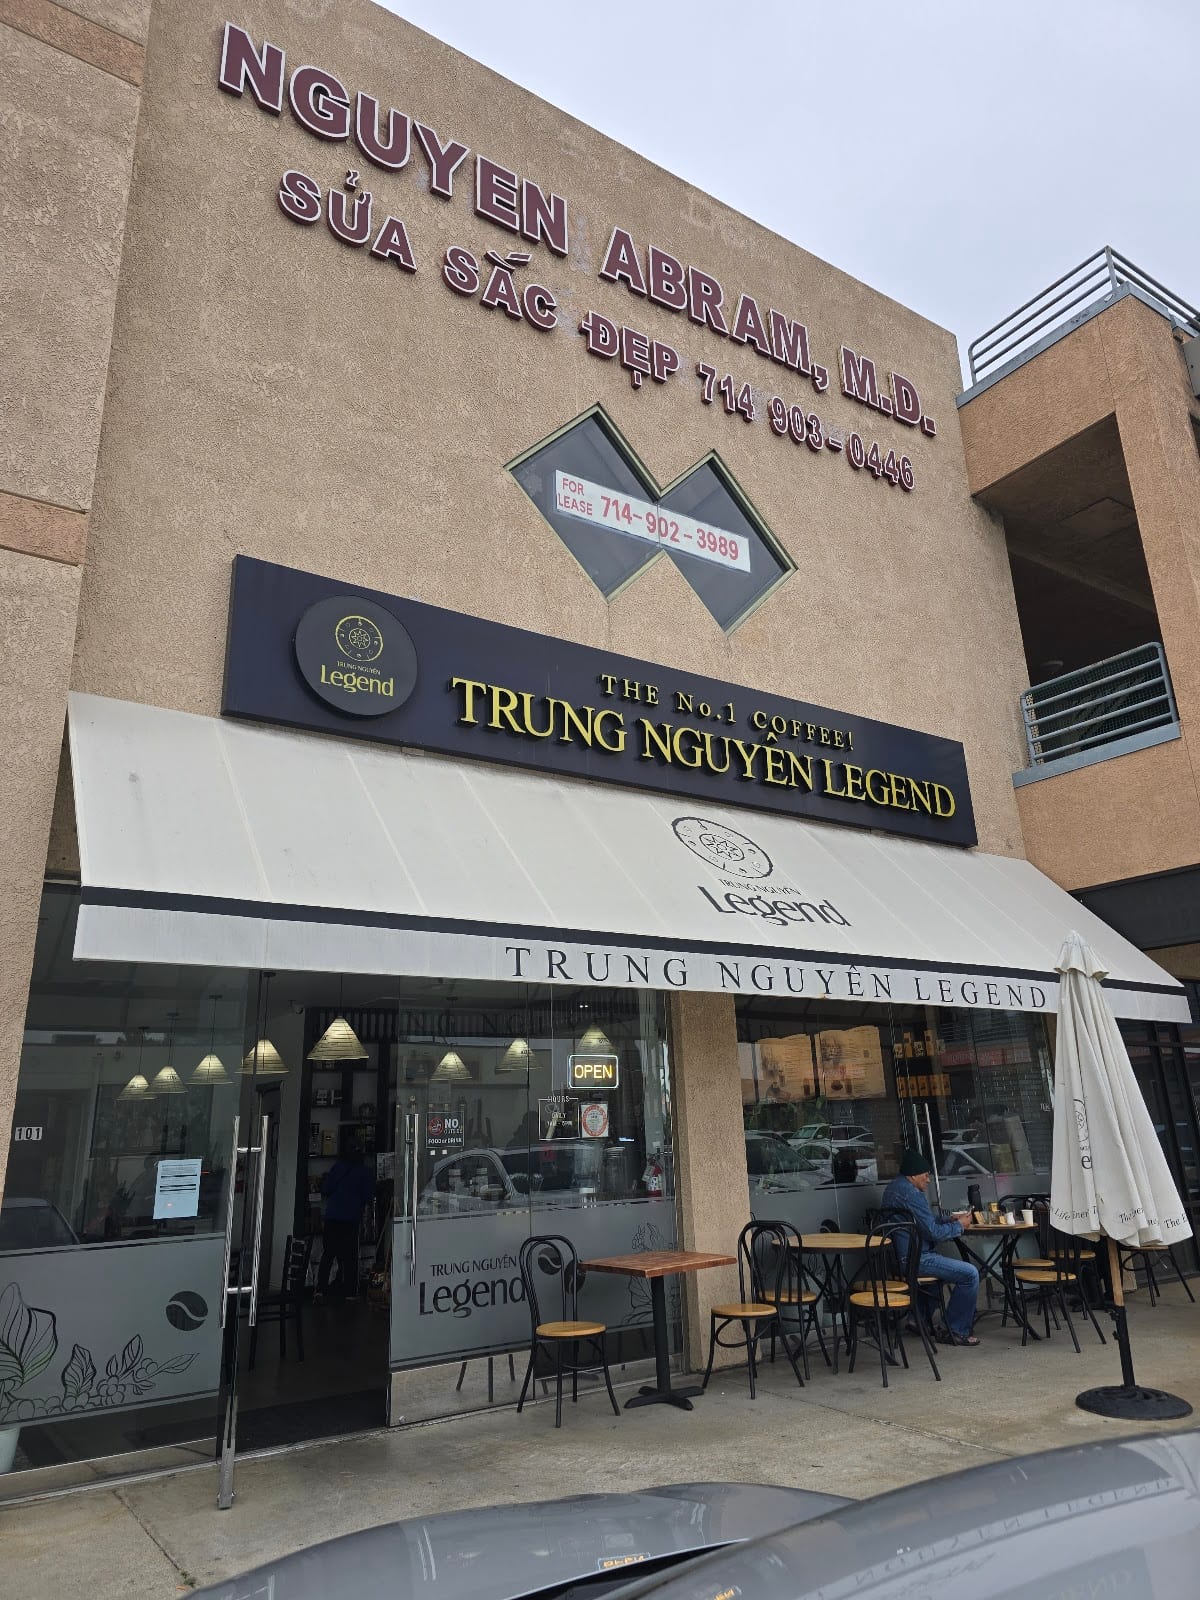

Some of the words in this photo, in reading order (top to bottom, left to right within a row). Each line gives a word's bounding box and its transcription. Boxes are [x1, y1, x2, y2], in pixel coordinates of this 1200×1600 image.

[219, 21, 568, 258] NGUYEN
[599, 226, 829, 393] ABRAM,
[838, 345, 937, 437] M.D.
[277, 169, 417, 274] SỬA
[443, 245, 557, 331] SẮC
[578, 310, 680, 389] ĐẸP
[697, 362, 756, 422] 714
[767, 396, 915, 491] 903-0446
[562, 477, 584, 497] FOR
[557, 493, 593, 516] LEASE
[600, 495, 740, 561] 714-902-3989
[320, 664, 394, 697] Legend
[600, 673, 660, 706] THE
[674, 691, 737, 724] No.1
[752, 710, 855, 751] COFFEE!
[450, 676, 628, 753] TRUNG
[639, 717, 815, 793] NGUYÊN
[821, 757, 956, 818] LEGEND
[696, 885, 852, 927] Legend
[504, 945, 689, 988] TRUNG
[718, 961, 894, 999] NGUYÊN
[914, 976, 1047, 1009] LEGEND
[574, 1064, 613, 1079] OPEN
[547, 1095, 570, 1103] HOURS
[16, 1127, 41, 1140] 101
[444, 1118, 459, 1129] NO
[1054, 1207, 1071, 1221] Life
[430, 1260, 470, 1277] TRUNG
[472, 1253, 517, 1272] NGUYÊN
[418, 1276, 527, 1319] Legend
